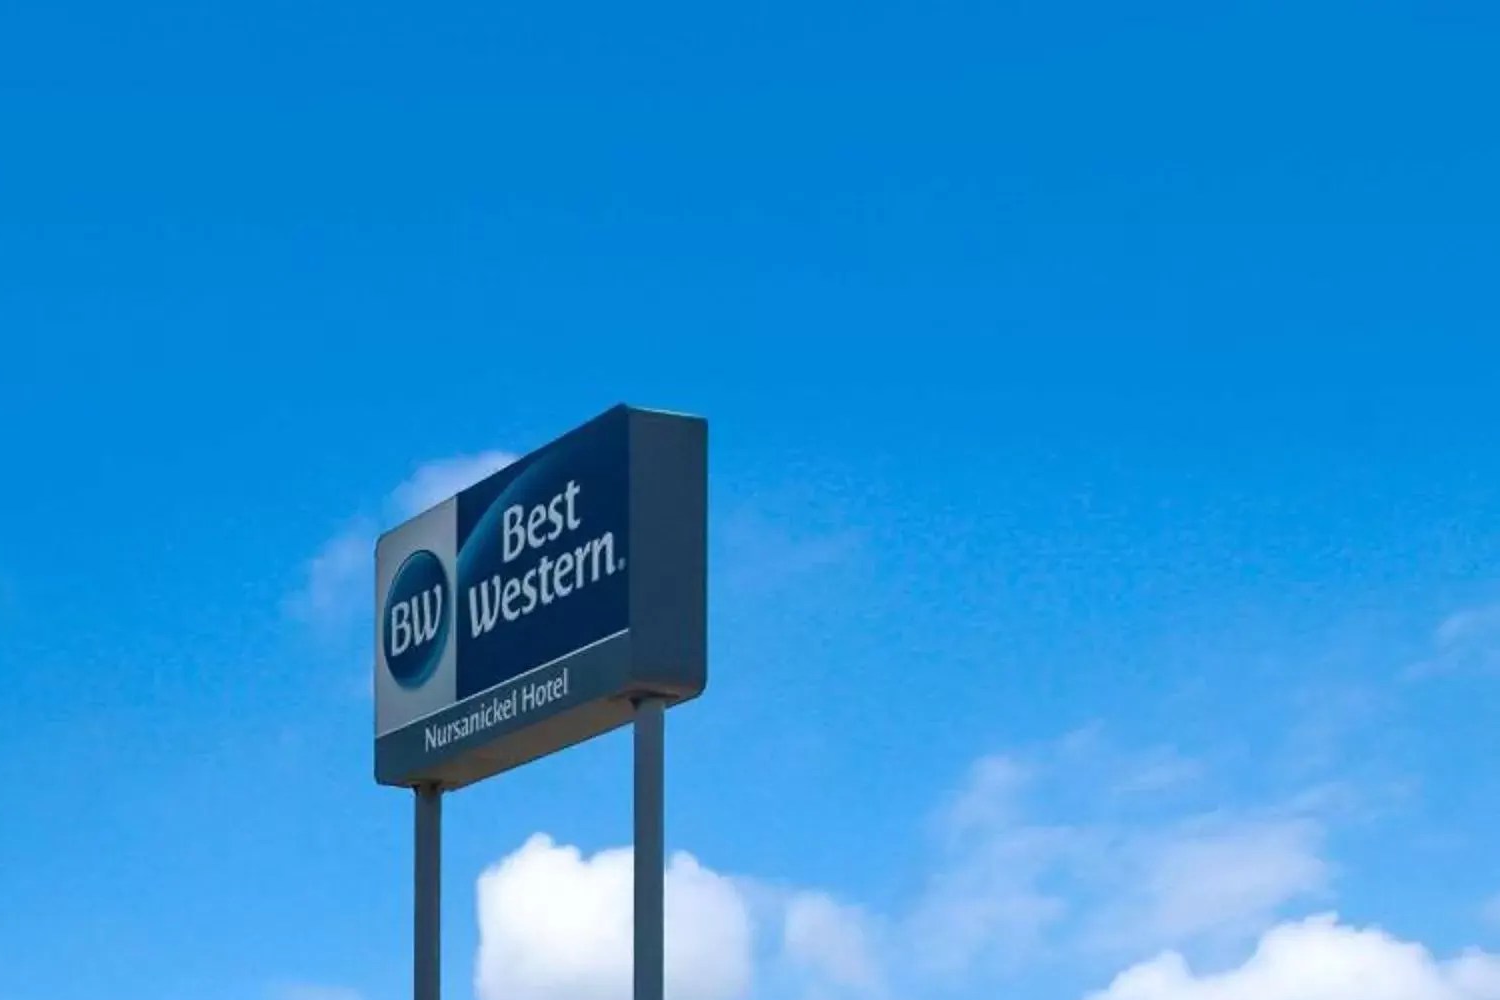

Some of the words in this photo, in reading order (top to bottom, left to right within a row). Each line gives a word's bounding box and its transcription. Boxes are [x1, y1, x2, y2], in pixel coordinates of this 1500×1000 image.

[502, 479, 581, 563] Best
[391, 584, 442, 657] BW
[424, 689, 517, 752] Nursanickel
[522, 667, 568, 713] Hotel
